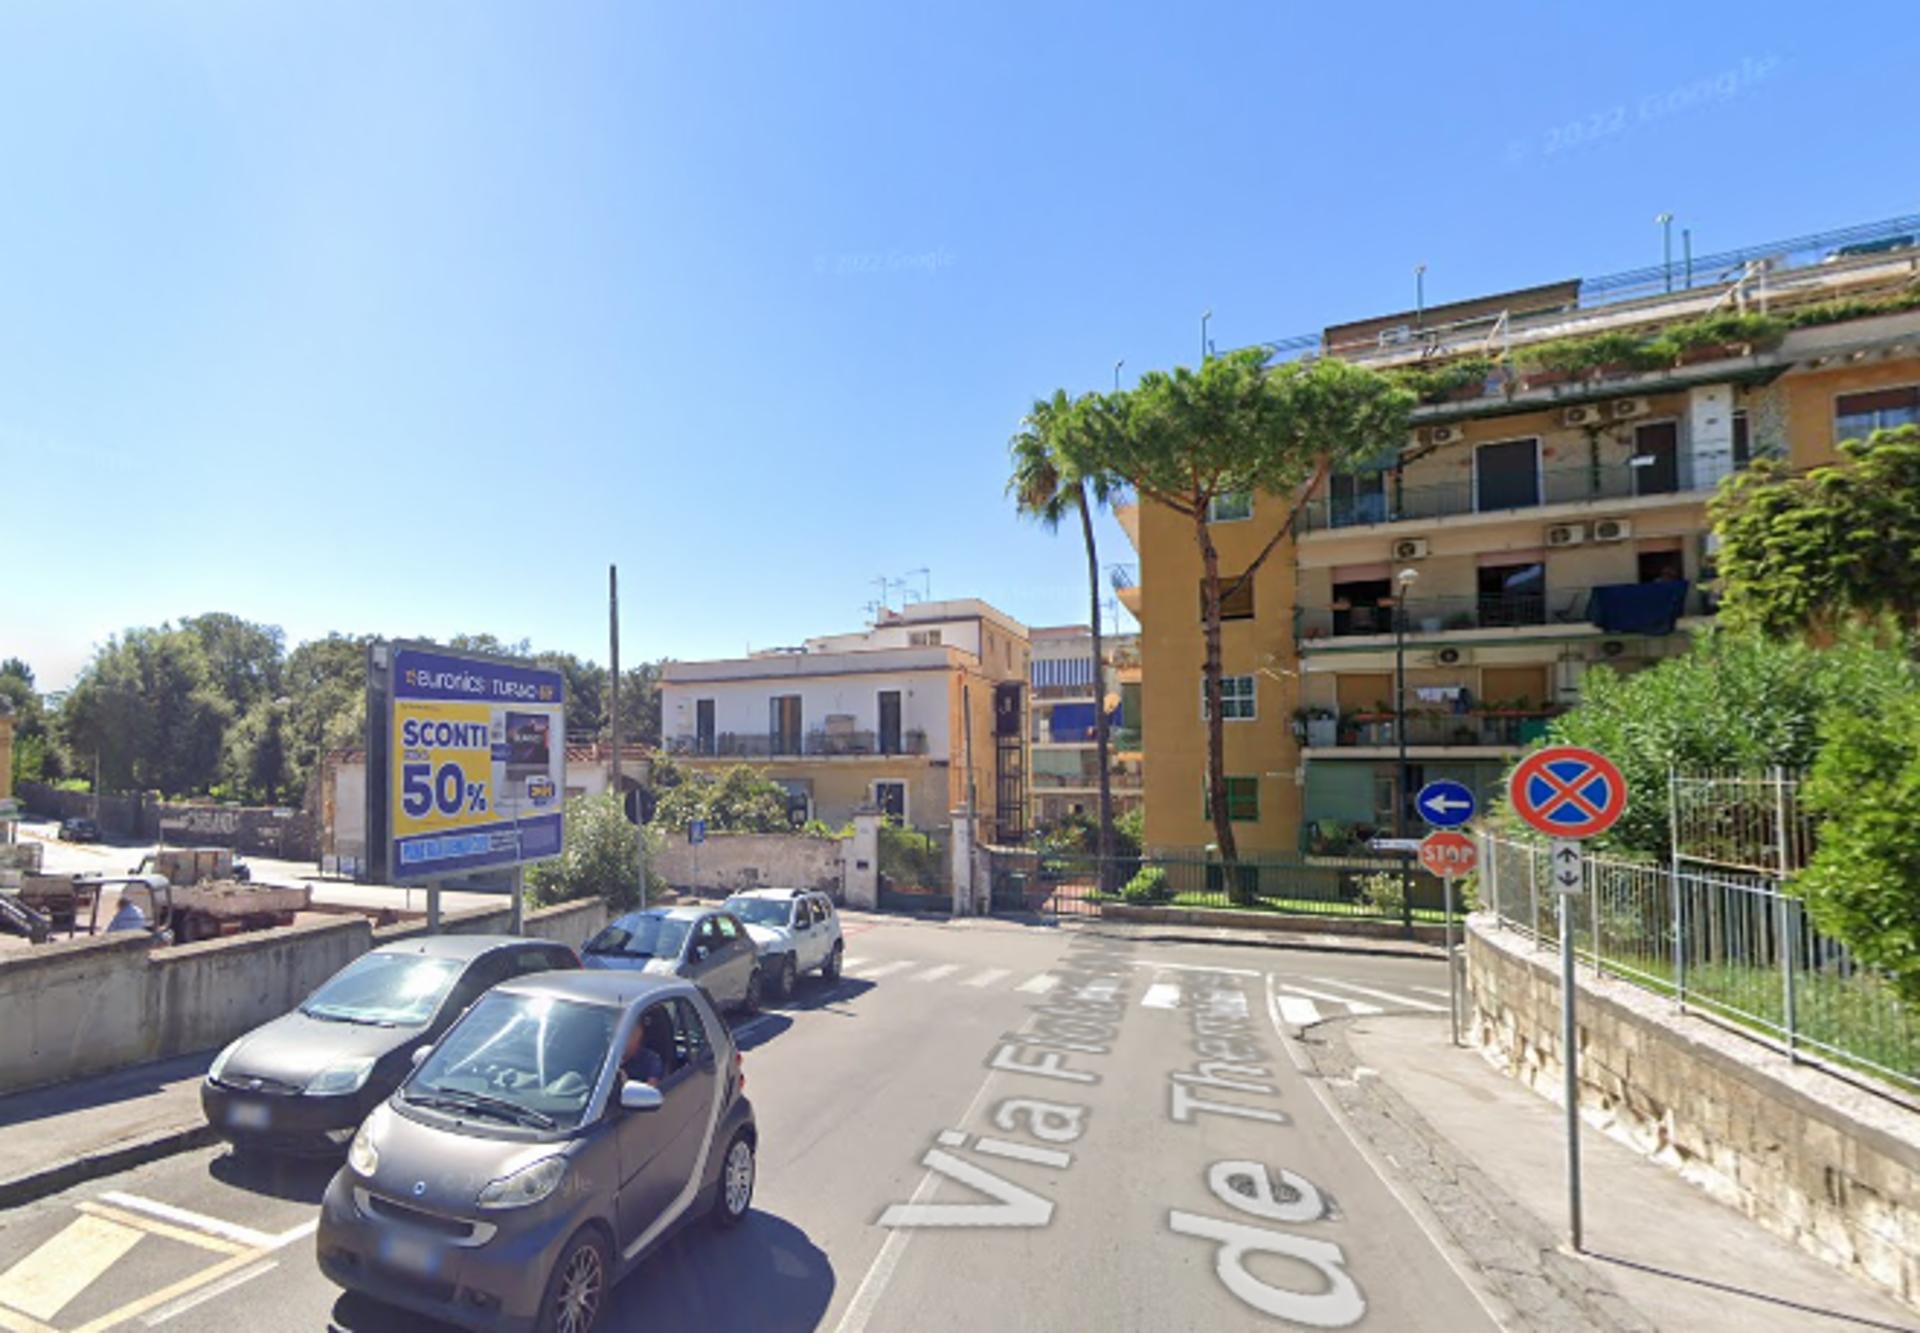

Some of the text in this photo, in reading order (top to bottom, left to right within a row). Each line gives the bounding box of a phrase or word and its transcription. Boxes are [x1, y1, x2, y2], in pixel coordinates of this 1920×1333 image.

[403, 719, 488, 748] SCONTI
[403, 763, 487, 818] 50%
[1423, 845, 1473, 864] STOP
